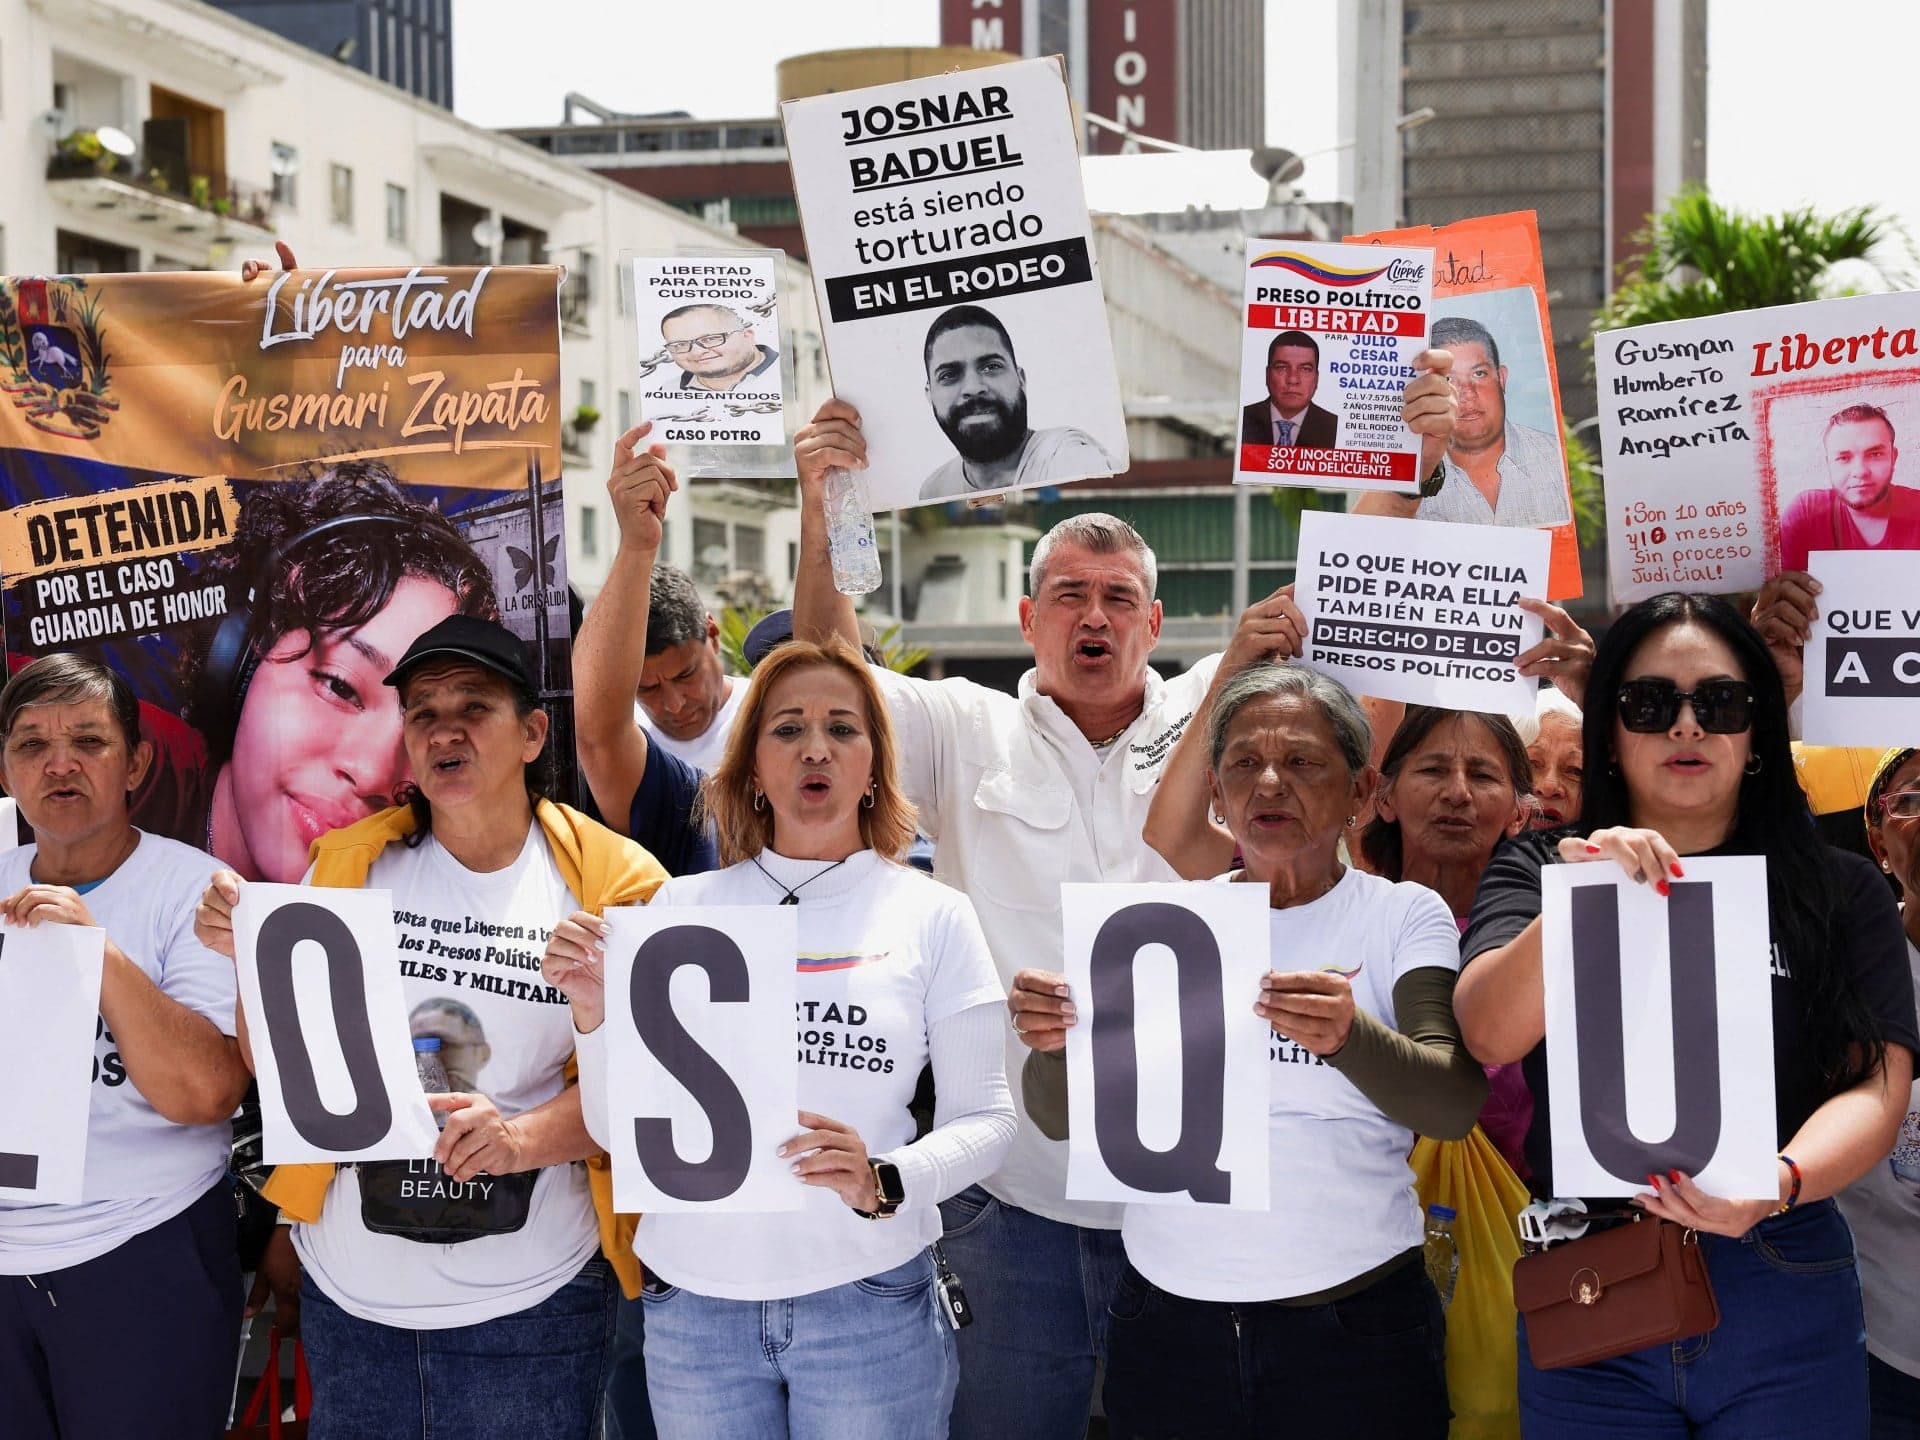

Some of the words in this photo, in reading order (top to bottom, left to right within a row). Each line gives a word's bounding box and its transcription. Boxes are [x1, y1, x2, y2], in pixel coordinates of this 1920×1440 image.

[1114, 0, 1147, 155] ION
[841, 86, 1011, 141] JOSNAR
[850, 134, 1021, 188] BADUEL
[854, 196, 914, 228] está
[924, 181, 1025, 217] siendo
[855, 210, 1043, 265] torturado
[661, 265, 752, 276] LIBERTAD
[852, 280, 897, 310] EN
[904, 274, 943, 303] EL
[949, 253, 1066, 295] RODEO
[1434, 250, 1493, 288] rtad
[649, 277, 698, 287] PARA
[704, 278, 765, 288] DENYS
[658, 289, 758, 299] CUSTODIO.
[260, 267, 493, 349] Libertad
[1256, 287, 1320, 305] PRESO
[1327, 289, 1421, 310] POLÍTICO
[1274, 308, 1399, 334] LIBERTAD
[1325, 333, 1349, 341] PARA
[1352, 335, 1397, 348] JULIO
[1350, 349, 1398, 362] CESAR
[1615, 339, 1734, 365] Gusman
[1750, 325, 1919, 376] Liberta
[337, 344, 408, 390] para
[1330, 362, 1417, 378] RODRIGUEZ
[644, 391, 781, 401] #QUESEANTODOS
[1339, 377, 1406, 391] SALAZAR
[213, 374, 390, 444] Gusmari
[401, 368, 549, 455] Zapata
[1350, 401, 1373, 411] AÑOS
[1362, 414, 1402, 422] LIBERTAD
[665, 429, 706, 441] CASO
[710, 429, 761, 442] POTRO
[1369, 424, 1399, 432] RODEO
[1270, 447, 1296, 459] SOY
[1300, 448, 1366, 463] INOCENTE.
[1369, 453, 1390, 464] NO
[1345, 440, 1385, 449] SEPTIEMBRE
[1267, 458, 1297, 471] SOY
[1297, 461, 1316, 472] UN
[1318, 462, 1392, 476] DELICUENTE
[27, 486, 227, 567] DETENIDA
[1625, 501, 1666, 527] ¡Son
[1675, 504, 1697, 520] 10
[1705, 501, 1747, 518] años
[1675, 522, 1747, 541] meses
[1318, 551, 1349, 568] LO
[1356, 554, 1405, 574] QUE
[1411, 559, 1462, 579] HOY
[1467, 564, 1528, 584] CILIA
[1672, 546, 1751, 568] proceso
[36, 574, 81, 609] POR
[86, 569, 113, 600] EL
[117, 558, 175, 595] CASO
[1632, 565, 1722, 584] Judicial!
[505, 596, 518, 612] LA
[1317, 574, 1377, 596] PIDE
[1384, 579, 1455, 603] PARA
[1462, 587, 1521, 608] ELLA
[30, 604, 126, 647] GUARDIA
[129, 597, 159, 630] DE
[163, 585, 227, 624] HONOR
[1317, 598, 1424, 622] TAMBIÉN
[1434, 608, 1481, 627] ERA
[1491, 613, 1524, 630] UN
[1827, 610, 1892, 634] QUE
[1901, 610, 1920, 630] V
[1316, 624, 1428, 650] DERECHO
[1434, 635, 1466, 653] DE
[1472, 638, 1517, 657] LOS
[1312, 649, 1396, 672] PRESOS
[1402, 659, 1516, 683] POLÍTICOS
[1832, 651, 1871, 684] A
[1892, 651, 1920, 684] C
[431, 917, 462, 934] que
[464, 916, 523, 938] Liberen
[528, 930, 537, 940] a
[540, 928, 552, 942] to
[398, 934, 424, 951] los
[427, 939, 481, 961] Presos
[484, 946, 541, 972] Polític
[399, 960, 448, 981] ILES
[452, 970, 467, 986] Y
[470, 973, 569, 1005] MILITARE
[796, 1001, 867, 1026] TAD
[798, 1030, 835, 1047] OS
[845, 1033, 887, 1053] LOS
[1571, 881, 1722, 1186] U
[629, 924, 752, 1202] S
[1089, 902, 1231, 1205] Q
[401, 1180, 494, 1200] BEAUTY
